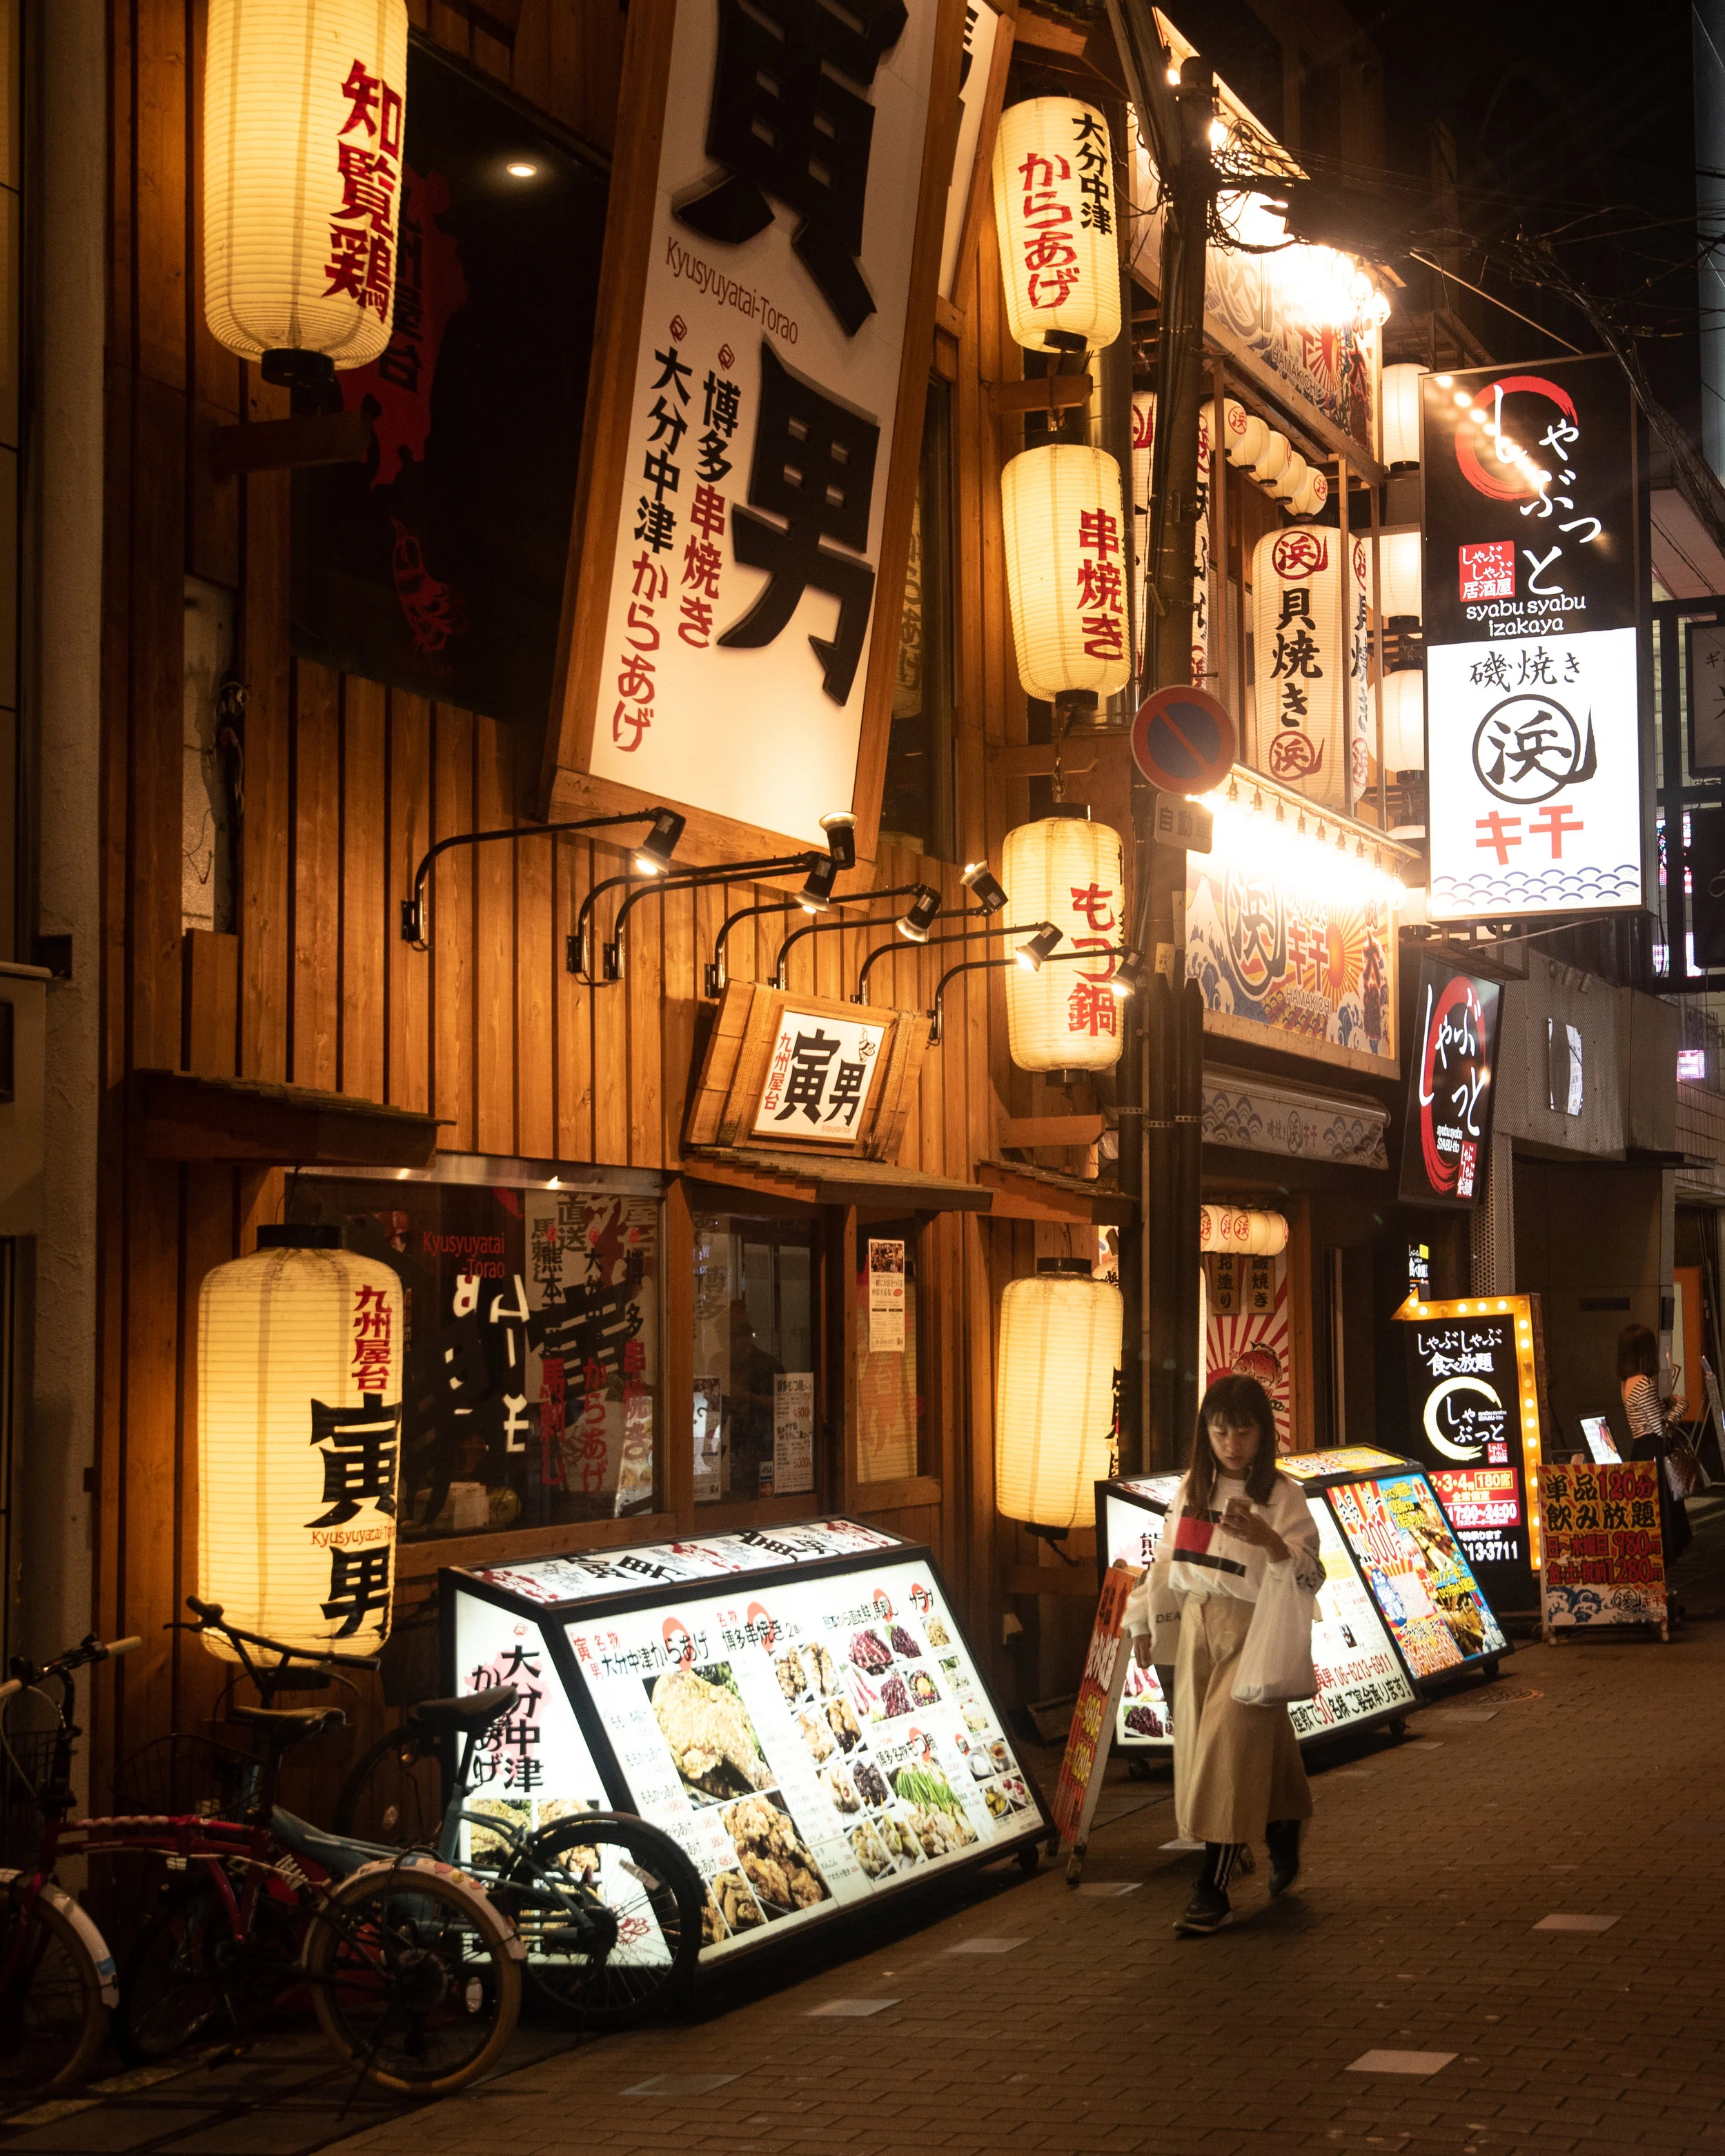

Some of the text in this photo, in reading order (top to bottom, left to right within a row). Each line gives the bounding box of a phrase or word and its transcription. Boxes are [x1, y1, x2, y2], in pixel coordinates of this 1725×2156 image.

[321, 59, 402, 324] 知覧鶏
[1072, 112, 1112, 235] 大分中津
[1018, 152, 1079, 310] からあげ
[666, 237, 798, 344] Kyusyuyatai-Torao
[1272, 348, 1321, 400] HAMAKICHI
[677, 370, 741, 649] 博多串焼き
[612, 344, 693, 753] 大分中津からあげ
[1462, 545, 1503, 565] しゃぶ
[1472, 561, 1513, 580] しゃぶ
[1077, 508, 1123, 661] 串焼き
[1463, 578, 1514, 600] 居酒屋
[1466, 594, 1586, 620] syabu syabu
[1489, 617, 1564, 637] izakaya
[1271, 587, 1323, 728] 貝焼き
[1470, 646, 1581, 693] 磯焼き
[1067, 882, 1116, 1037] もつ鍋
[1286, 986, 1332, 1016] HAMAKICHI
[765, 1032, 793, 1110] 九州屋台
[773, 1028, 867, 1126] 寅男
[423, 1231, 505, 1257] Kyusyuyatai
[462, 1258, 505, 1280] -Torao
[352, 1284, 392, 1392] 九州屋台
[1417, 1327, 1503, 1356] しゃぶしゃぶ
[1426, 1352, 1495, 1376] 食べ放題
[1545, 1500, 1657, 1532] 飲み放題
[594, 1629, 622, 1652] 名物
[601, 1629, 709, 1678] 大分中津からあげ
[722, 1619, 784, 1652] 博多串焼き
[1334, 1652, 1394, 1687] 06-6213-6911
[501, 1644, 544, 1792] 大分中津
